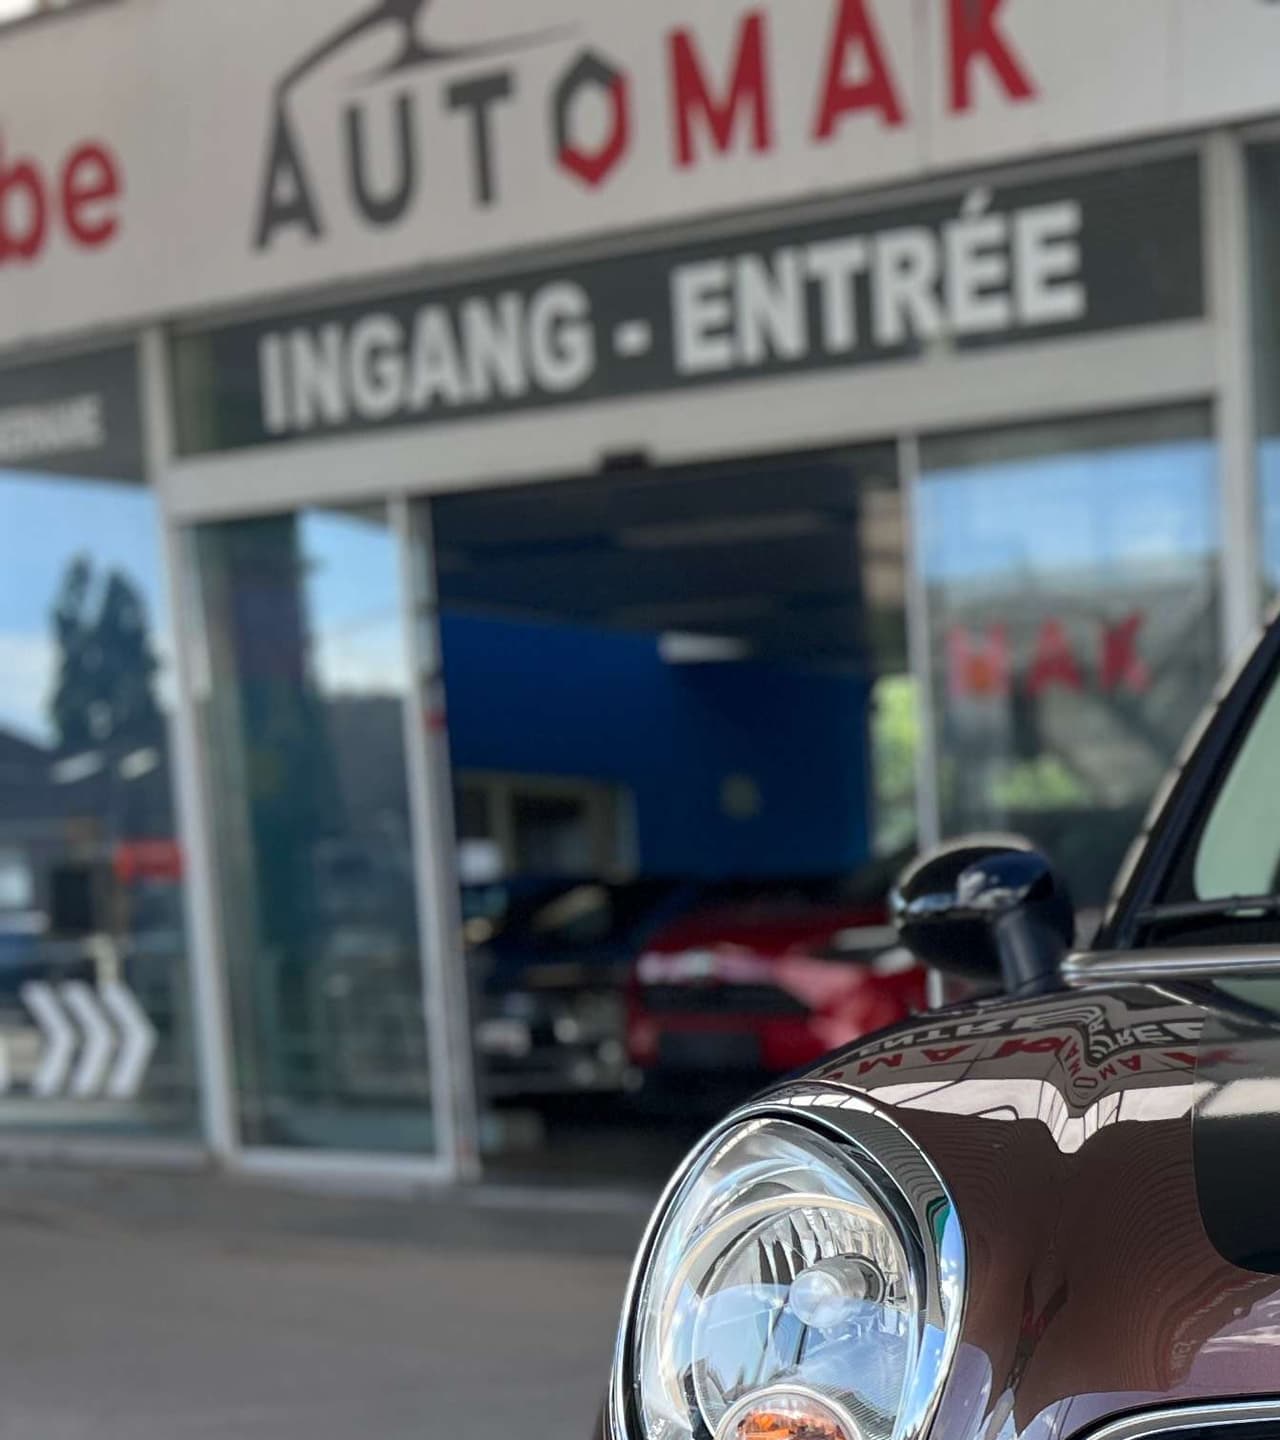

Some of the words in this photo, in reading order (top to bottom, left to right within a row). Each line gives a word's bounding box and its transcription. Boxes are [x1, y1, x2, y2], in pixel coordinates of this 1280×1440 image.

[253, 0, 1041, 253] AUTOMAK
[260, 283, 593, 433] INGANG
[669, 190, 1086, 373] ENTRÉE
